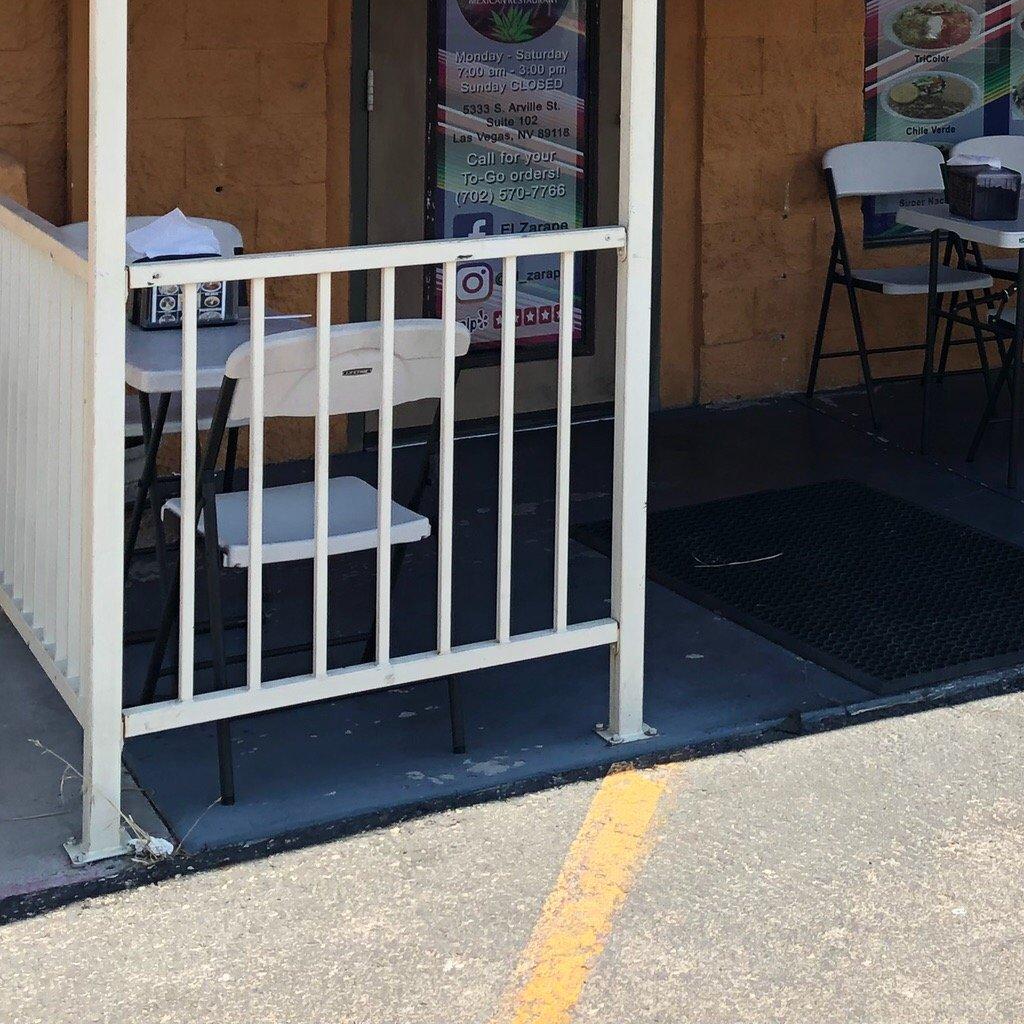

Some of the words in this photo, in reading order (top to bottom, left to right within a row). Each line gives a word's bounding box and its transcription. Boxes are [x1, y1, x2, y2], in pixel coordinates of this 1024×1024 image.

[455, 50, 504, 64] Monday
[516, 49, 569, 61] Saturday
[914, 54, 950, 64] TriColor
[458, 67, 485, 79] 7:00
[489, 67, 507, 77] am
[519, 64, 545, 76] 3:00
[548, 64, 567, 77] pm
[460, 82, 506, 95] Sunday
[511, 78, 564, 92] CLOSED
[463, 104, 490, 115] 5333
[494, 103, 505, 114] S.
[508, 101, 542, 112] Arville
[546, 100, 560, 111] St.
[486, 117, 514, 127] Suite
[519, 115, 538, 126] 102
[453, 133, 473, 143] Las
[475, 131, 514, 144] Vegas,
[518, 129, 535, 140] NV
[537, 127, 570, 138] 89118
[906, 127, 929, 136] Chile
[931, 125, 956, 135] Verde
[467, 152, 495, 166] Call
[500, 152, 520, 165] for
[524, 151, 557, 166] your
[462, 171, 506, 186] To-Go
[510, 166, 561, 182] orders!
[455, 188, 495, 207] (702)
[499, 183, 566, 202] 570-7766
[899, 198, 926, 208] Super
[501, 222, 515, 235] El
